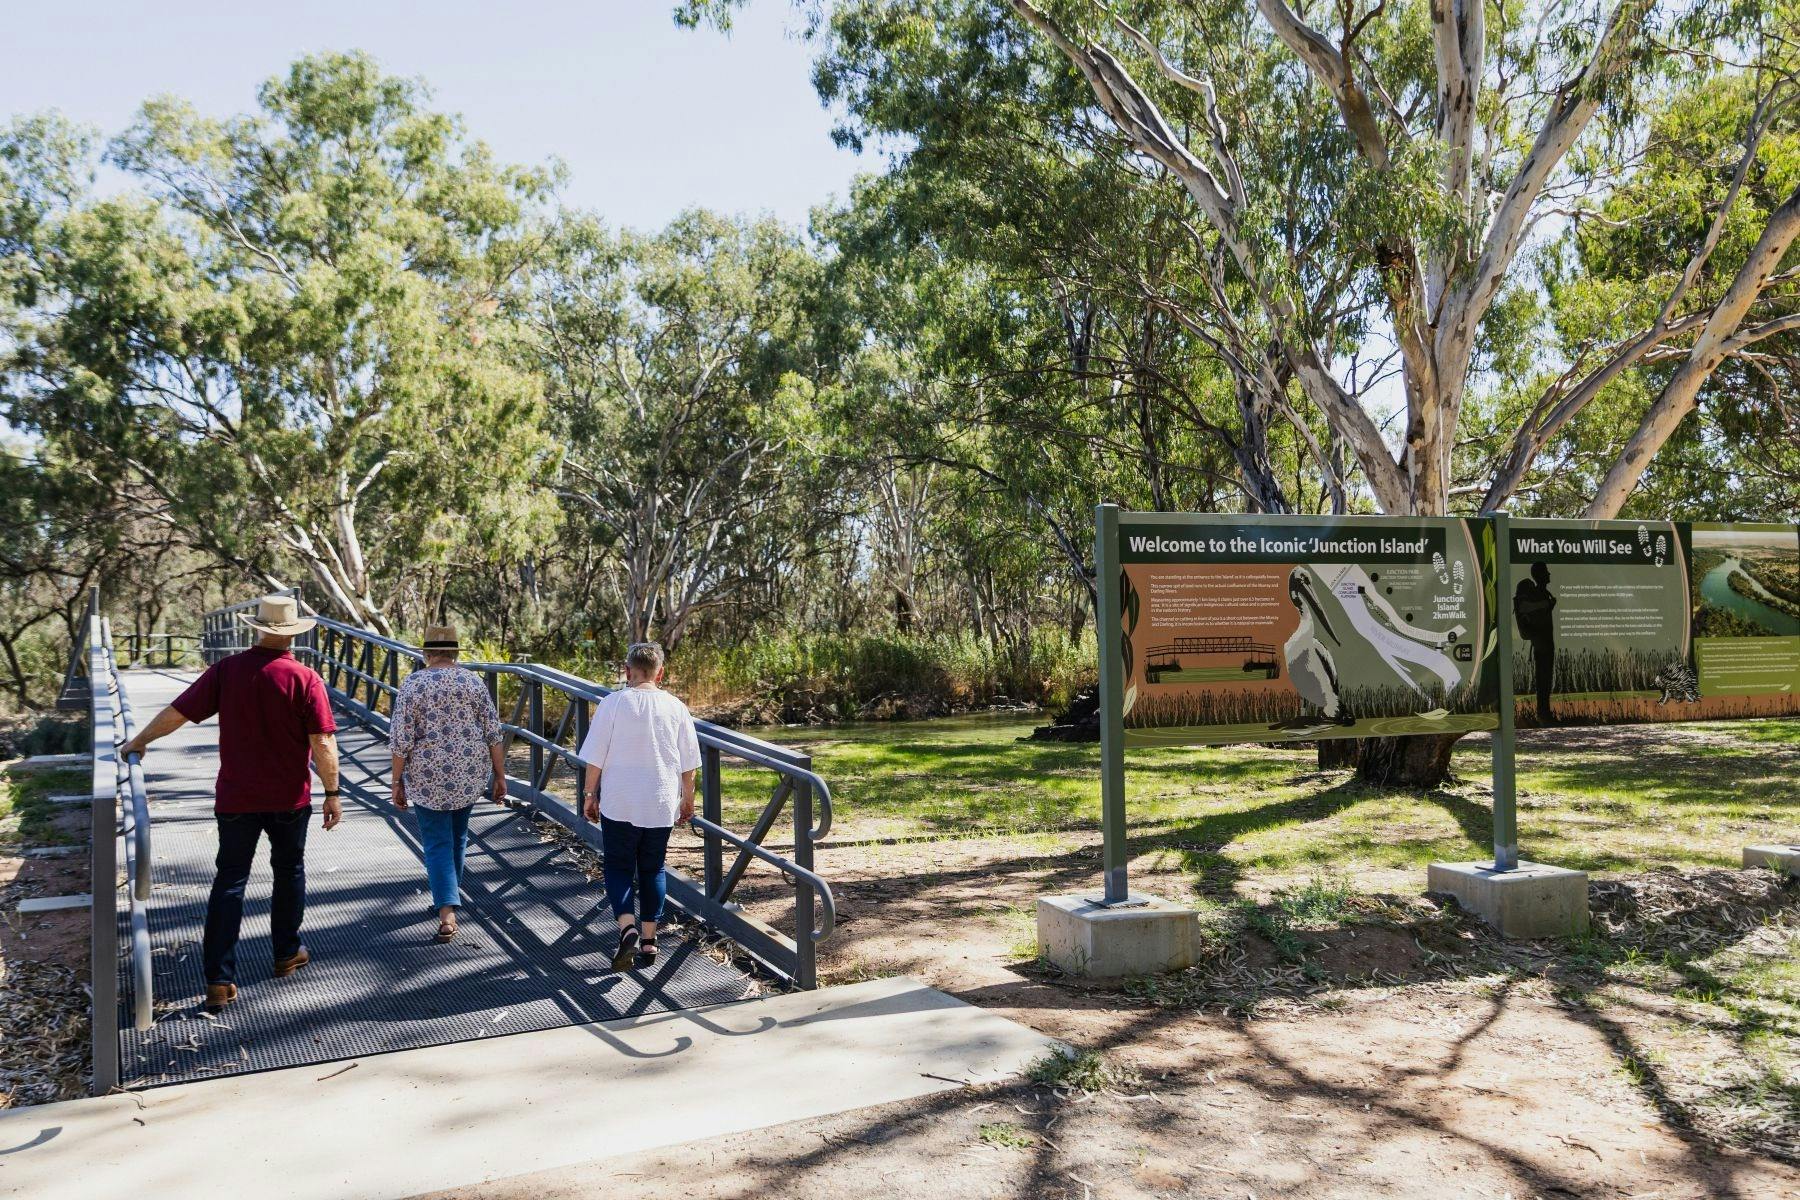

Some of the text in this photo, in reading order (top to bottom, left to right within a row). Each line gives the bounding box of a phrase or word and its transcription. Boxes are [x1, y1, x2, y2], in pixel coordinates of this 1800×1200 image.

[1129, 536, 1206, 553] Welcome
[1209, 538, 1226, 553] to
[1230, 537, 1256, 553] the
[1260, 537, 1307, 553] Iconic
[1517, 538, 1632, 554] What You Will See
[1433, 595, 1465, 603] Junction
[1437, 603, 1460, 611] Island
